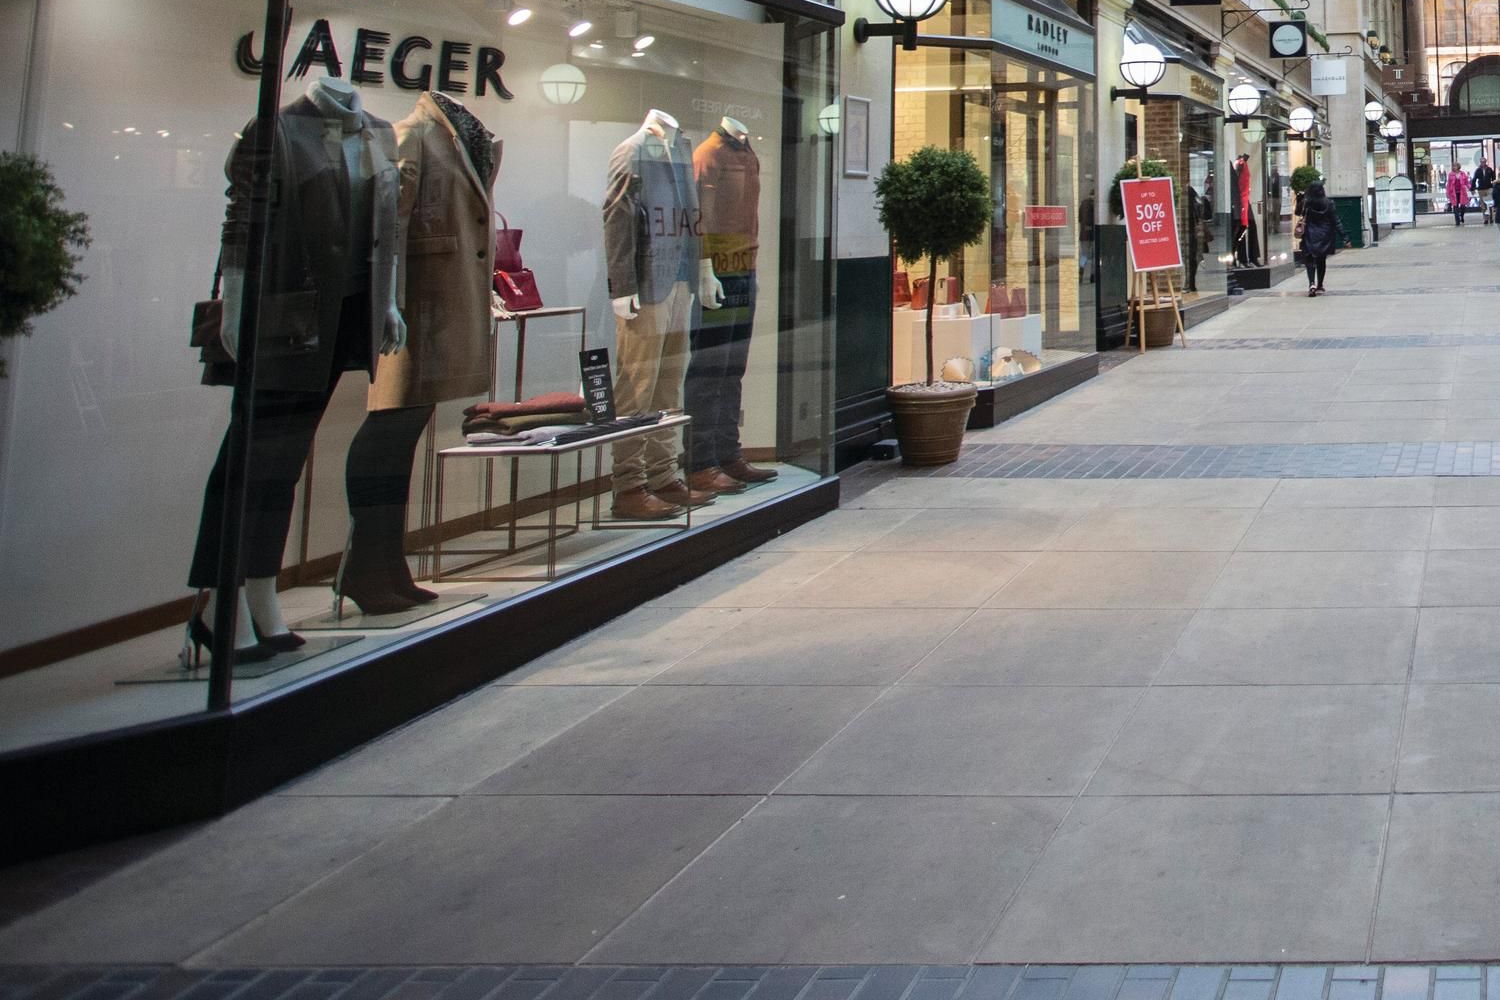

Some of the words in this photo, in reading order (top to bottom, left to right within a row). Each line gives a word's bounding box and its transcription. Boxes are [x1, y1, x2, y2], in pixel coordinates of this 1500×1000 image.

[1027, 13, 1069, 45] RADLEY
[235, 6, 515, 101] JAEGER
[1135, 203, 1166, 221] 50%
[1142, 221, 1163, 233] OFF
